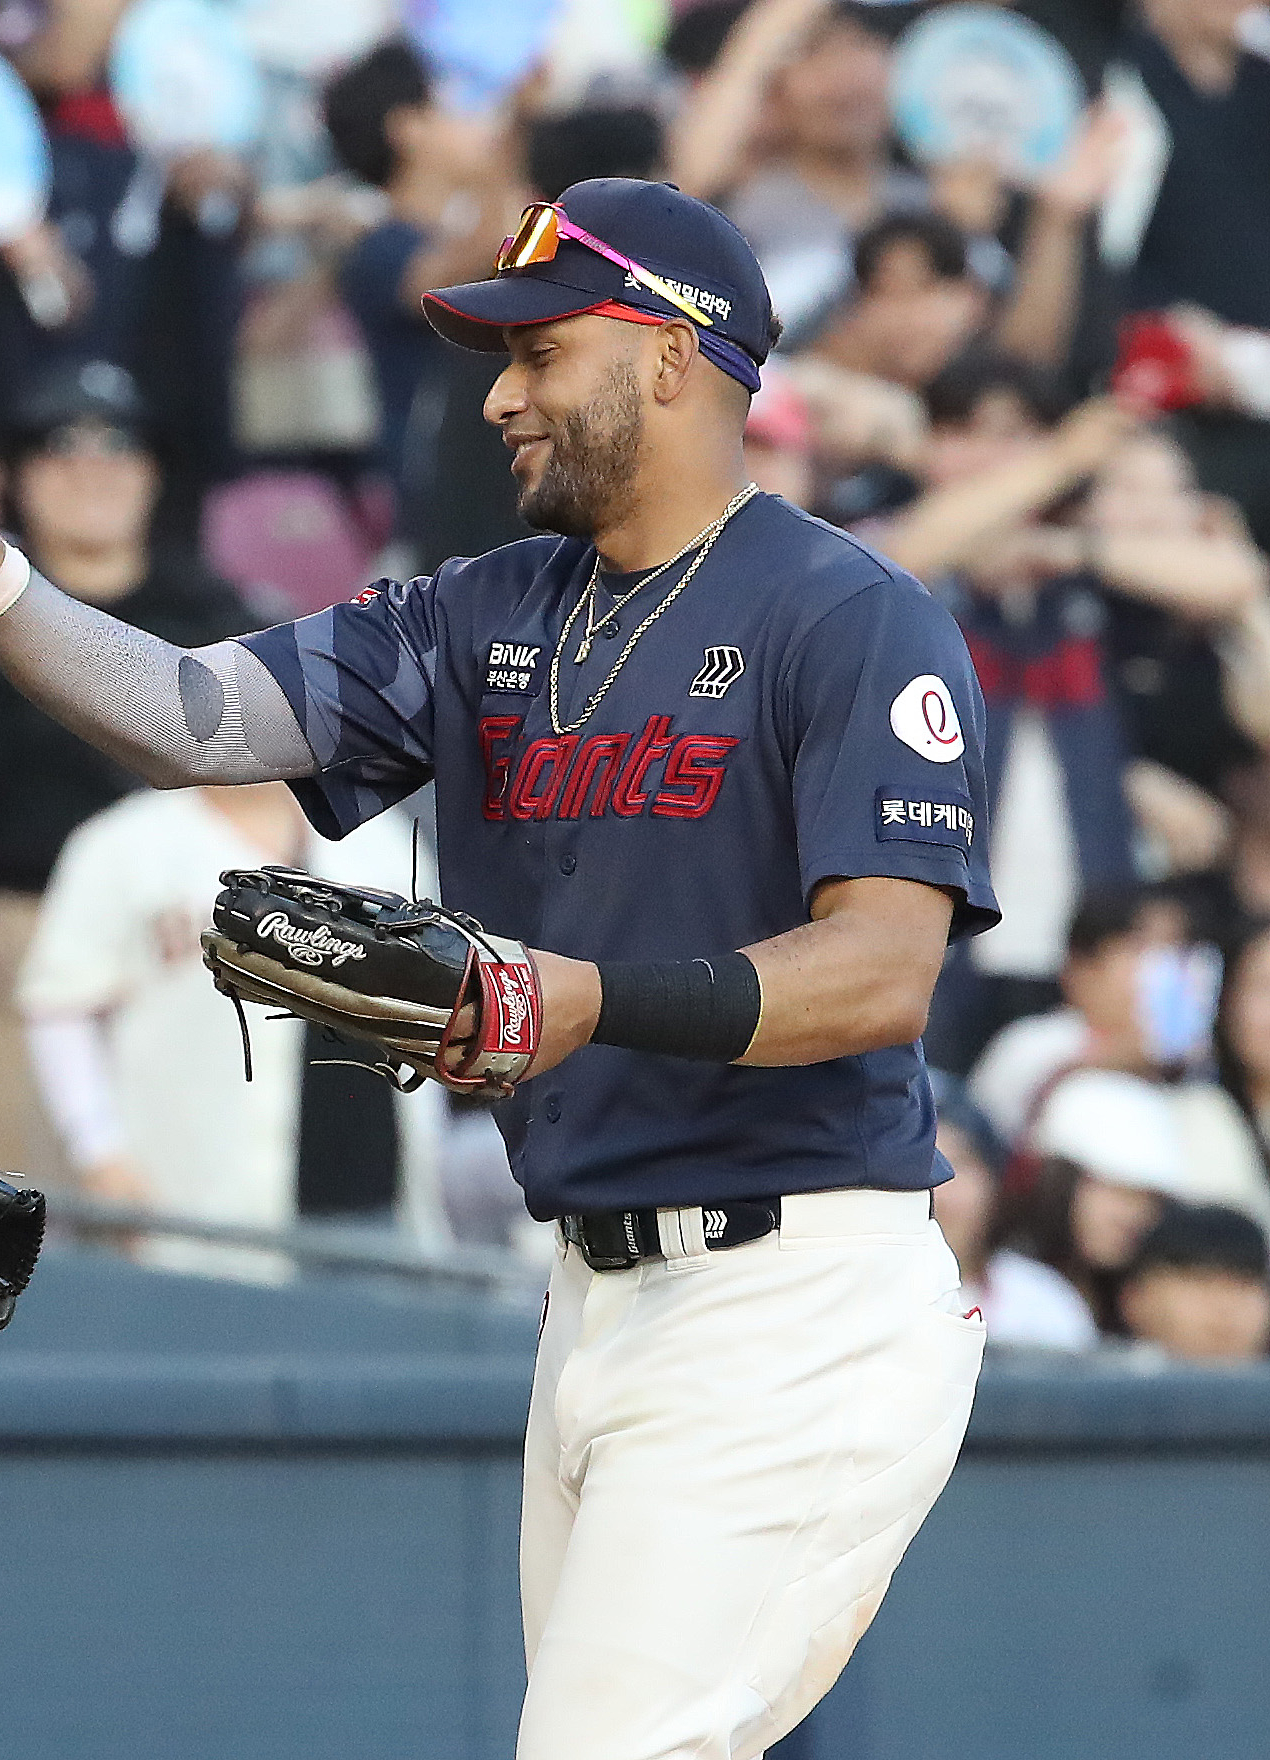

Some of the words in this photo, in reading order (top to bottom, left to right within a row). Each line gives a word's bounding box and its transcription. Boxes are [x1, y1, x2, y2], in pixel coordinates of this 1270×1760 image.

[489, 643, 541, 669] BNK
[487, 670, 531, 690] 부산은행
[691, 683, 726, 696] PLAY
[256, 911, 368, 968] Rawlings
[499, 968, 522, 1045] Rawlings
